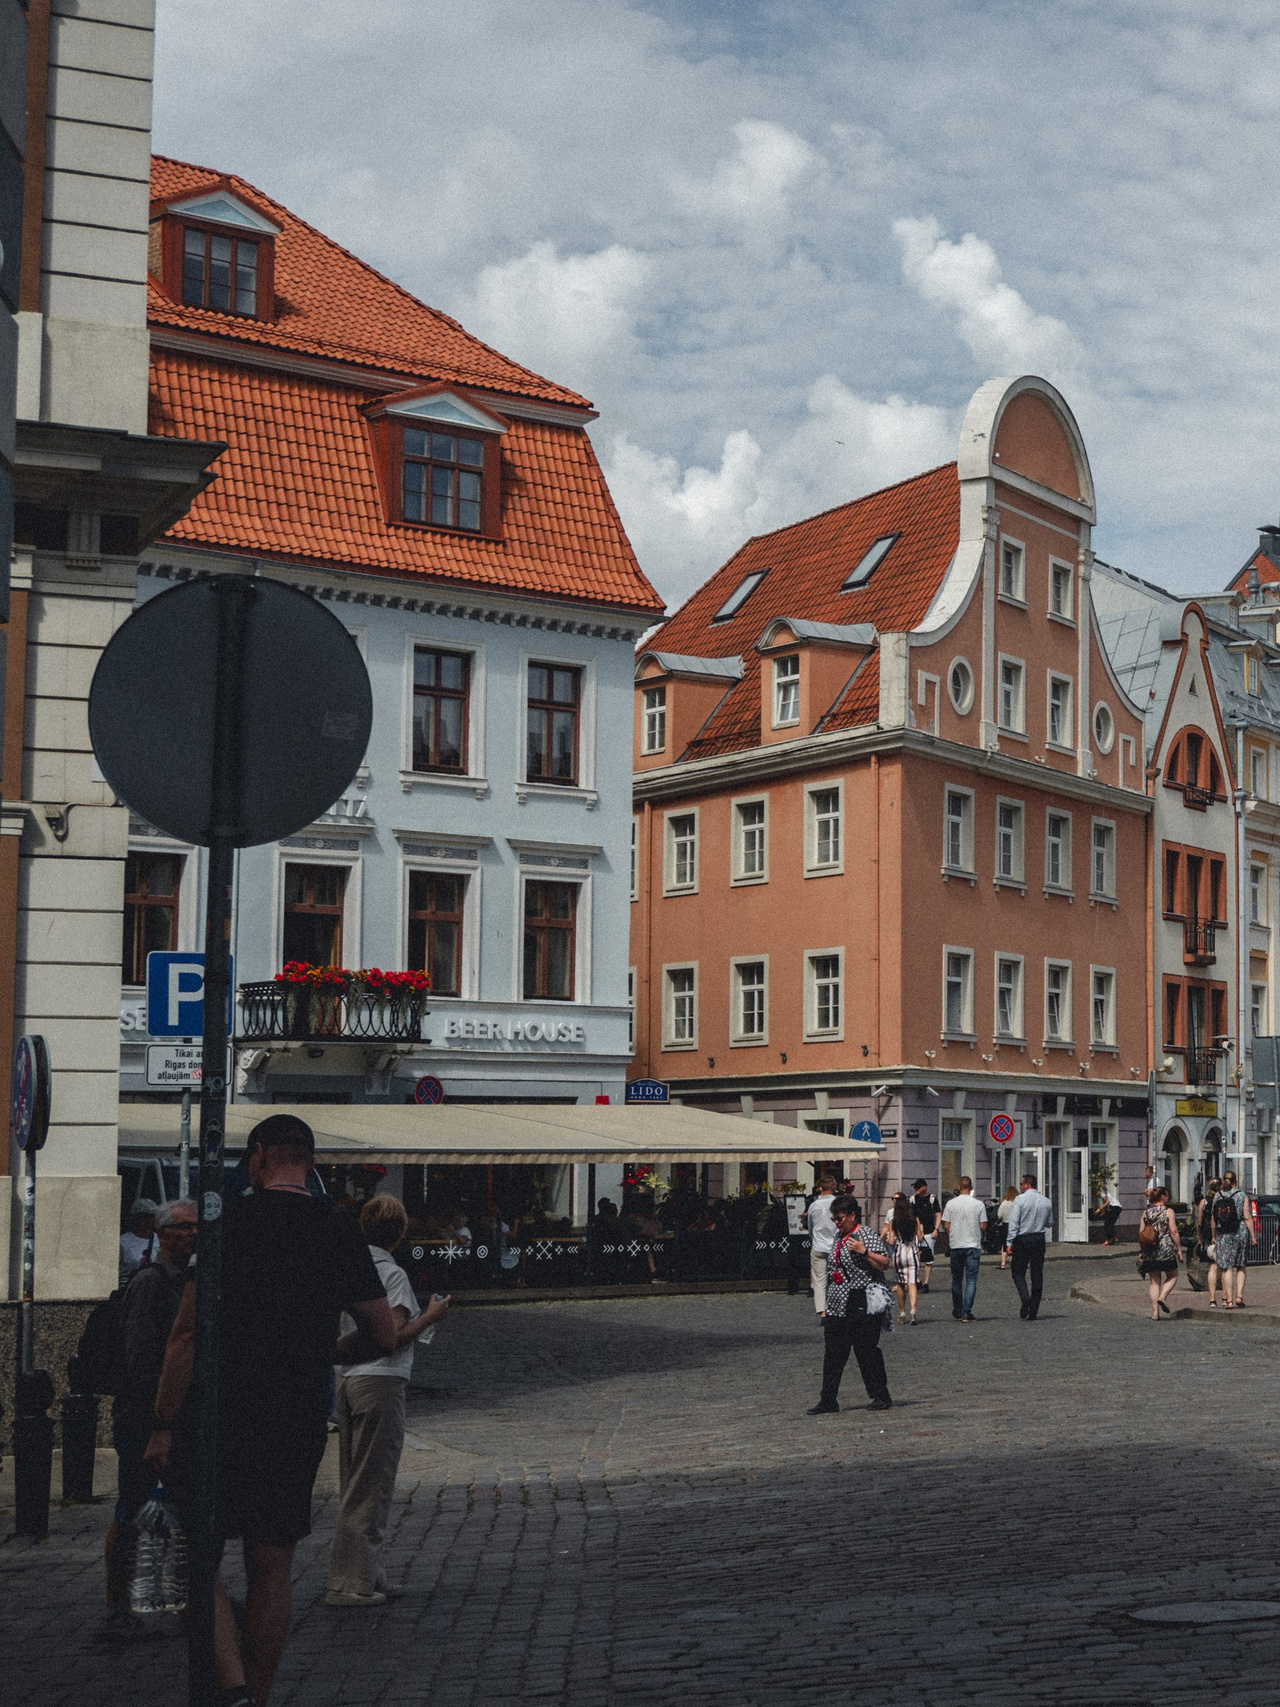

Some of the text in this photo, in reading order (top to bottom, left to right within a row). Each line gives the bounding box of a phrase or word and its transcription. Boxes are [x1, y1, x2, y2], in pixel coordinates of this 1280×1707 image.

[168, 963, 205, 1026] P
[444, 1018, 584, 1042] BEER HOUSE
[175, 1048, 194, 1058] Tikai
[188, 1060, 203, 1069] dom
[631, 1086, 663, 1096] LIDO
